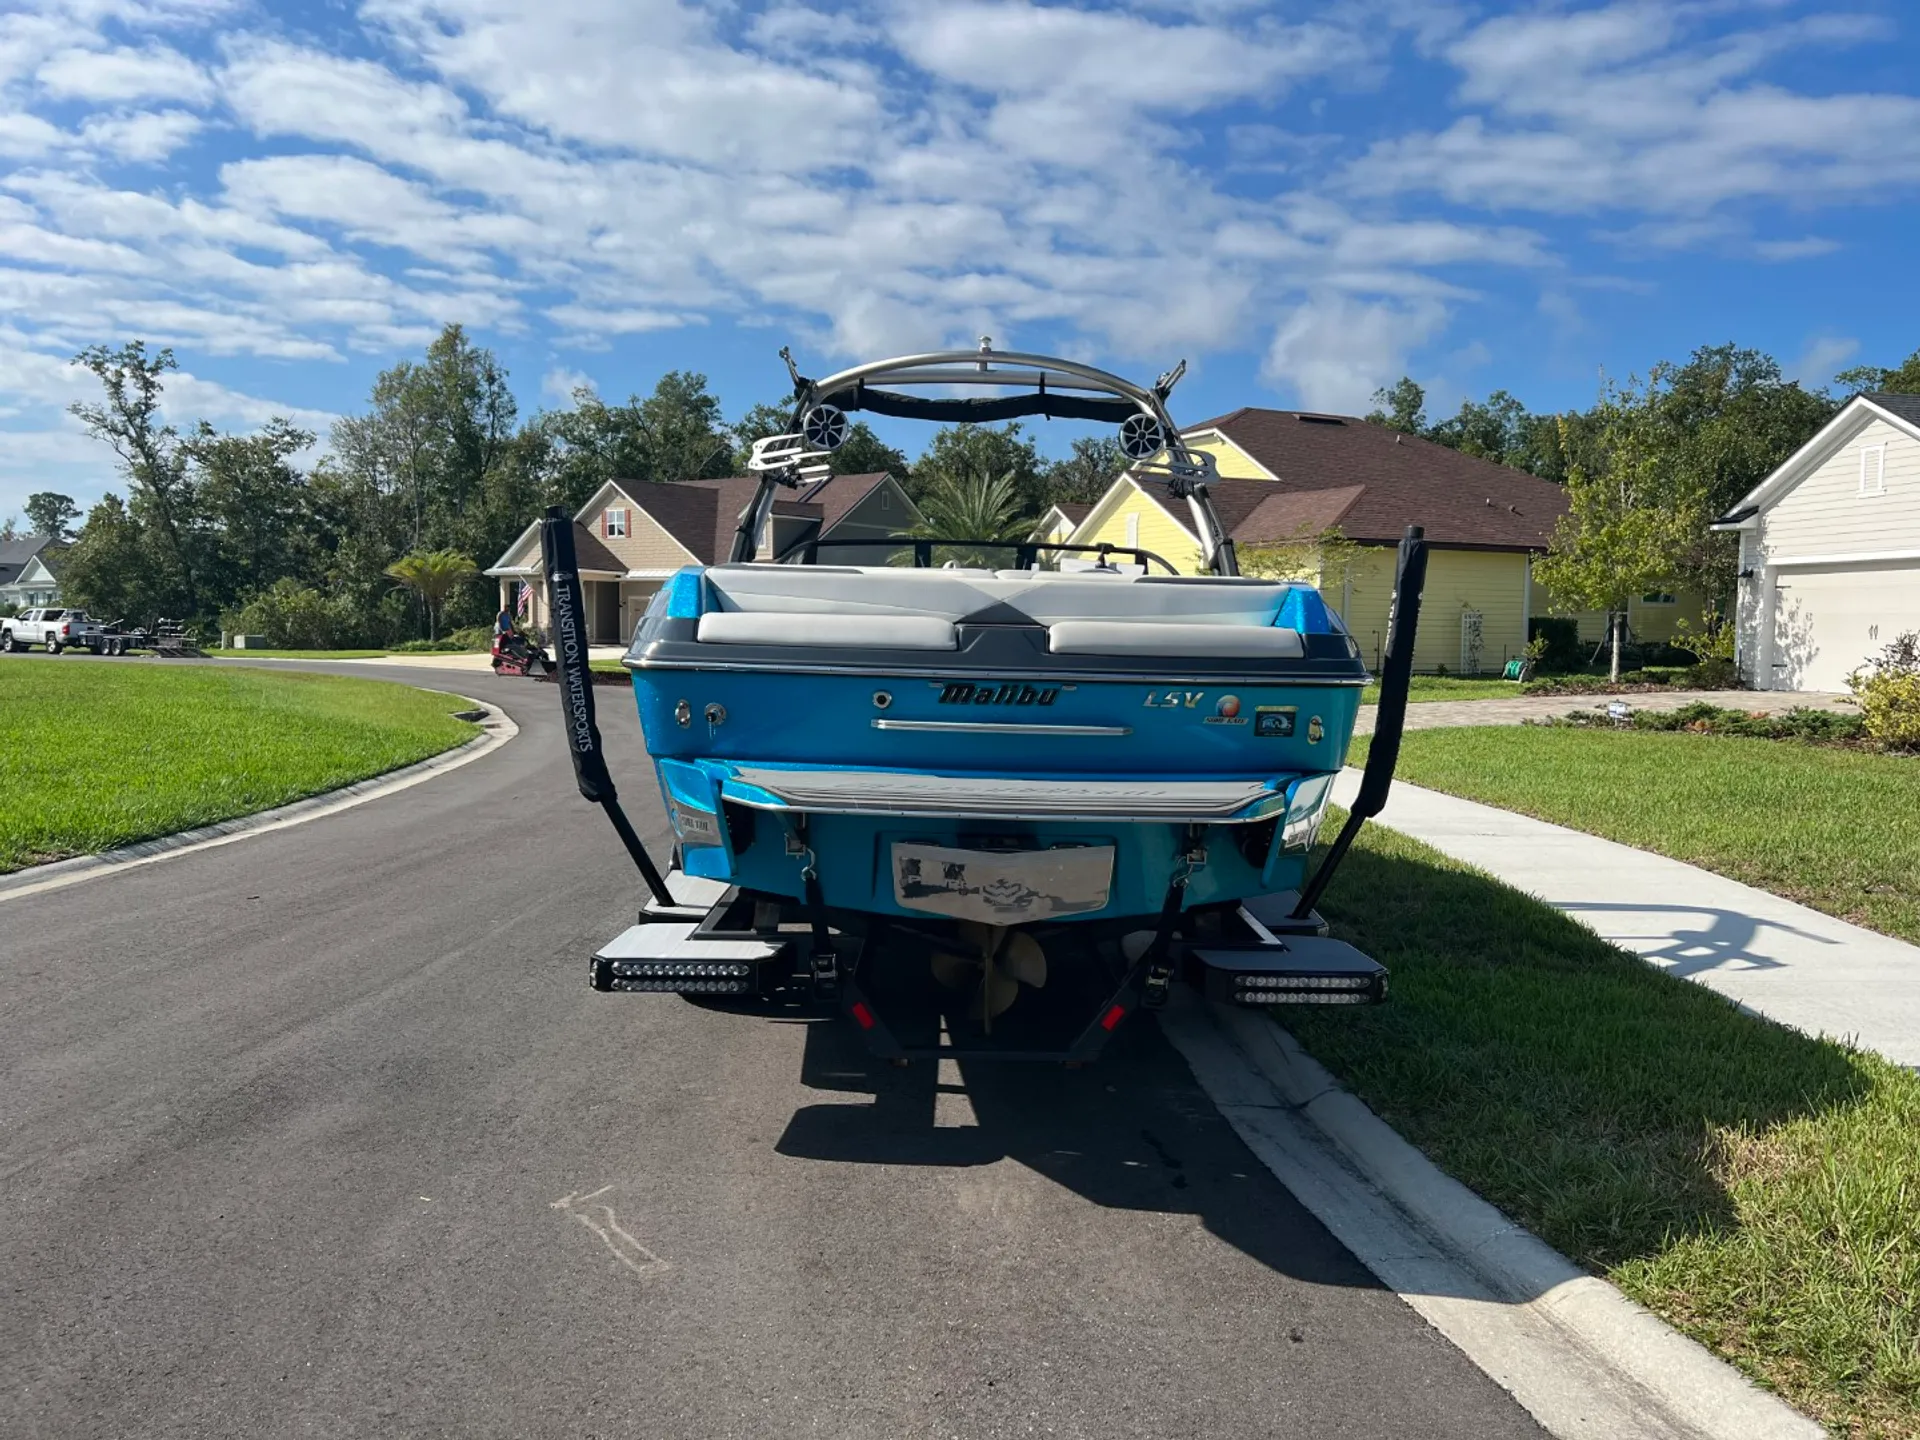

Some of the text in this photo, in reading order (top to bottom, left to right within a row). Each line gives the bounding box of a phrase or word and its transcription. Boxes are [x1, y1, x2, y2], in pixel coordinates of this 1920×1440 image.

[557, 584, 593, 752] TRANSITION WATERSPORTS
[938, 682, 1061, 707] Malibu
[1143, 692, 1204, 708] LSV
